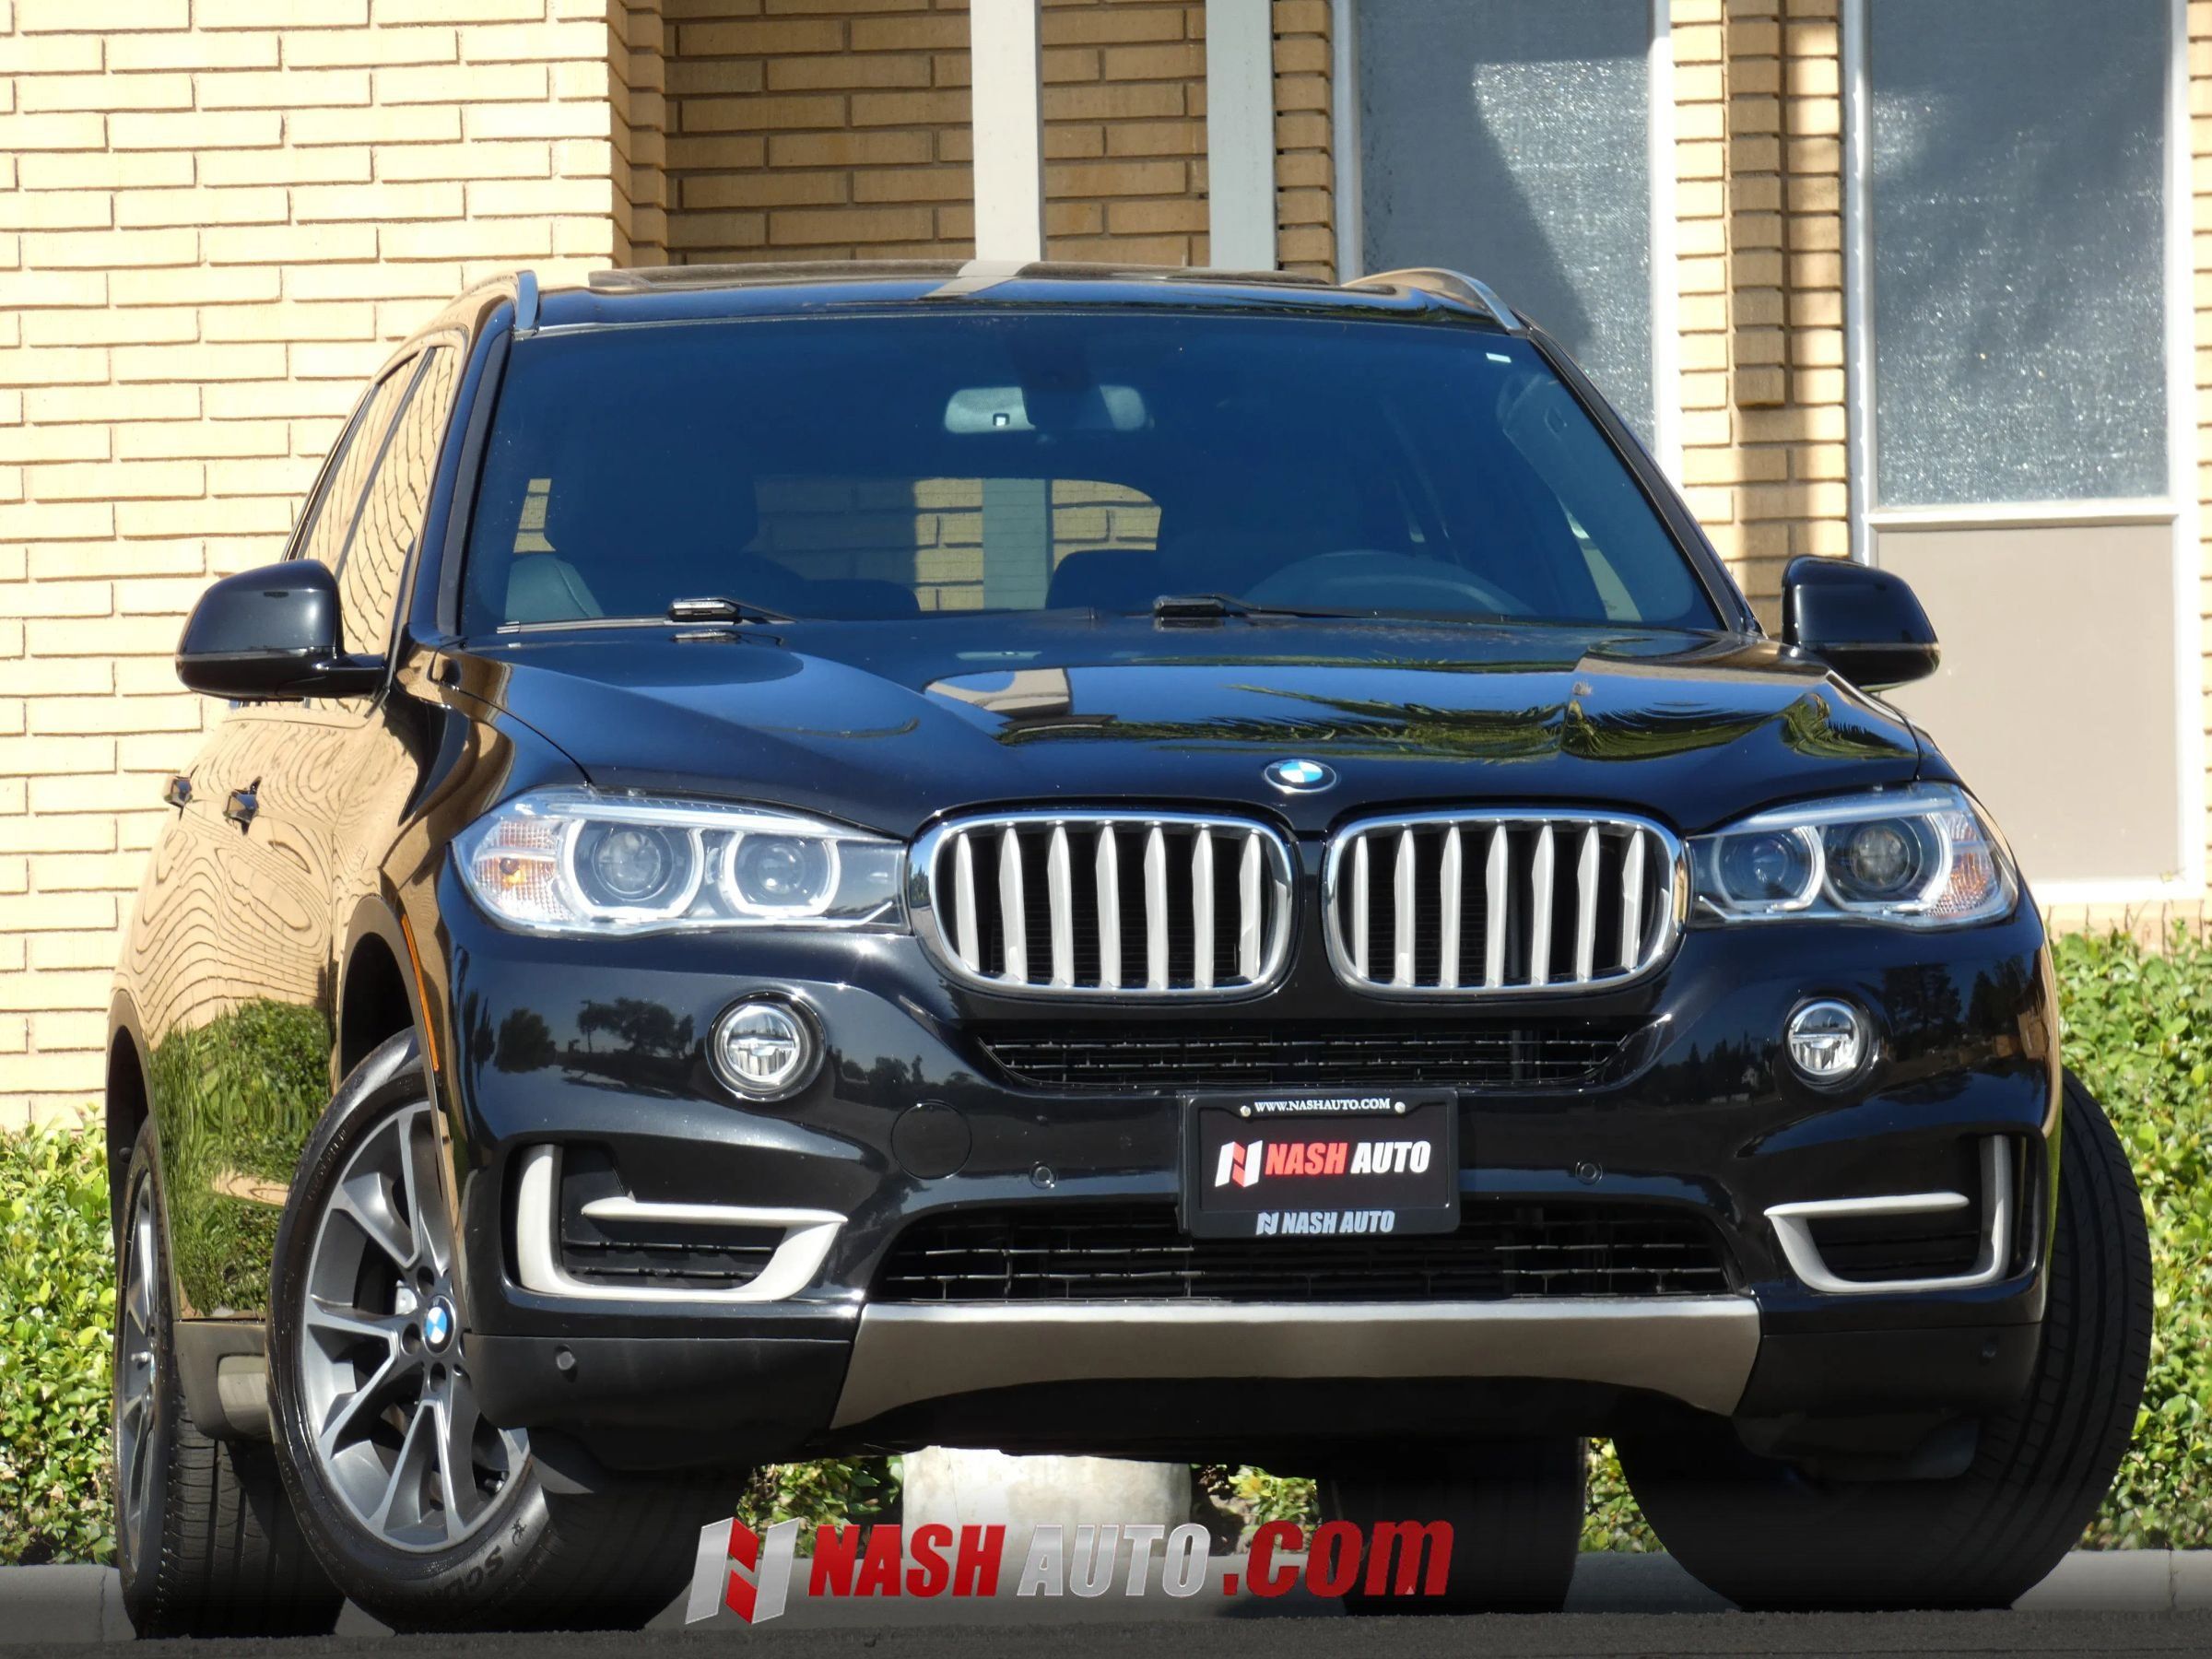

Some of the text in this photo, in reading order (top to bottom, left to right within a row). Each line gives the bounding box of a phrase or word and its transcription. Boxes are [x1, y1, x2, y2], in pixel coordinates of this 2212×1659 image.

[1254, 1098, 1390, 1112] WWW.NASHAUTO.COM
[1265, 1143, 1348, 1175] NASH
[1350, 1140, 1430, 1173] AUTO
[1282, 1212, 1338, 1234] NASH
[1339, 1210, 1395, 1233] AUTO
